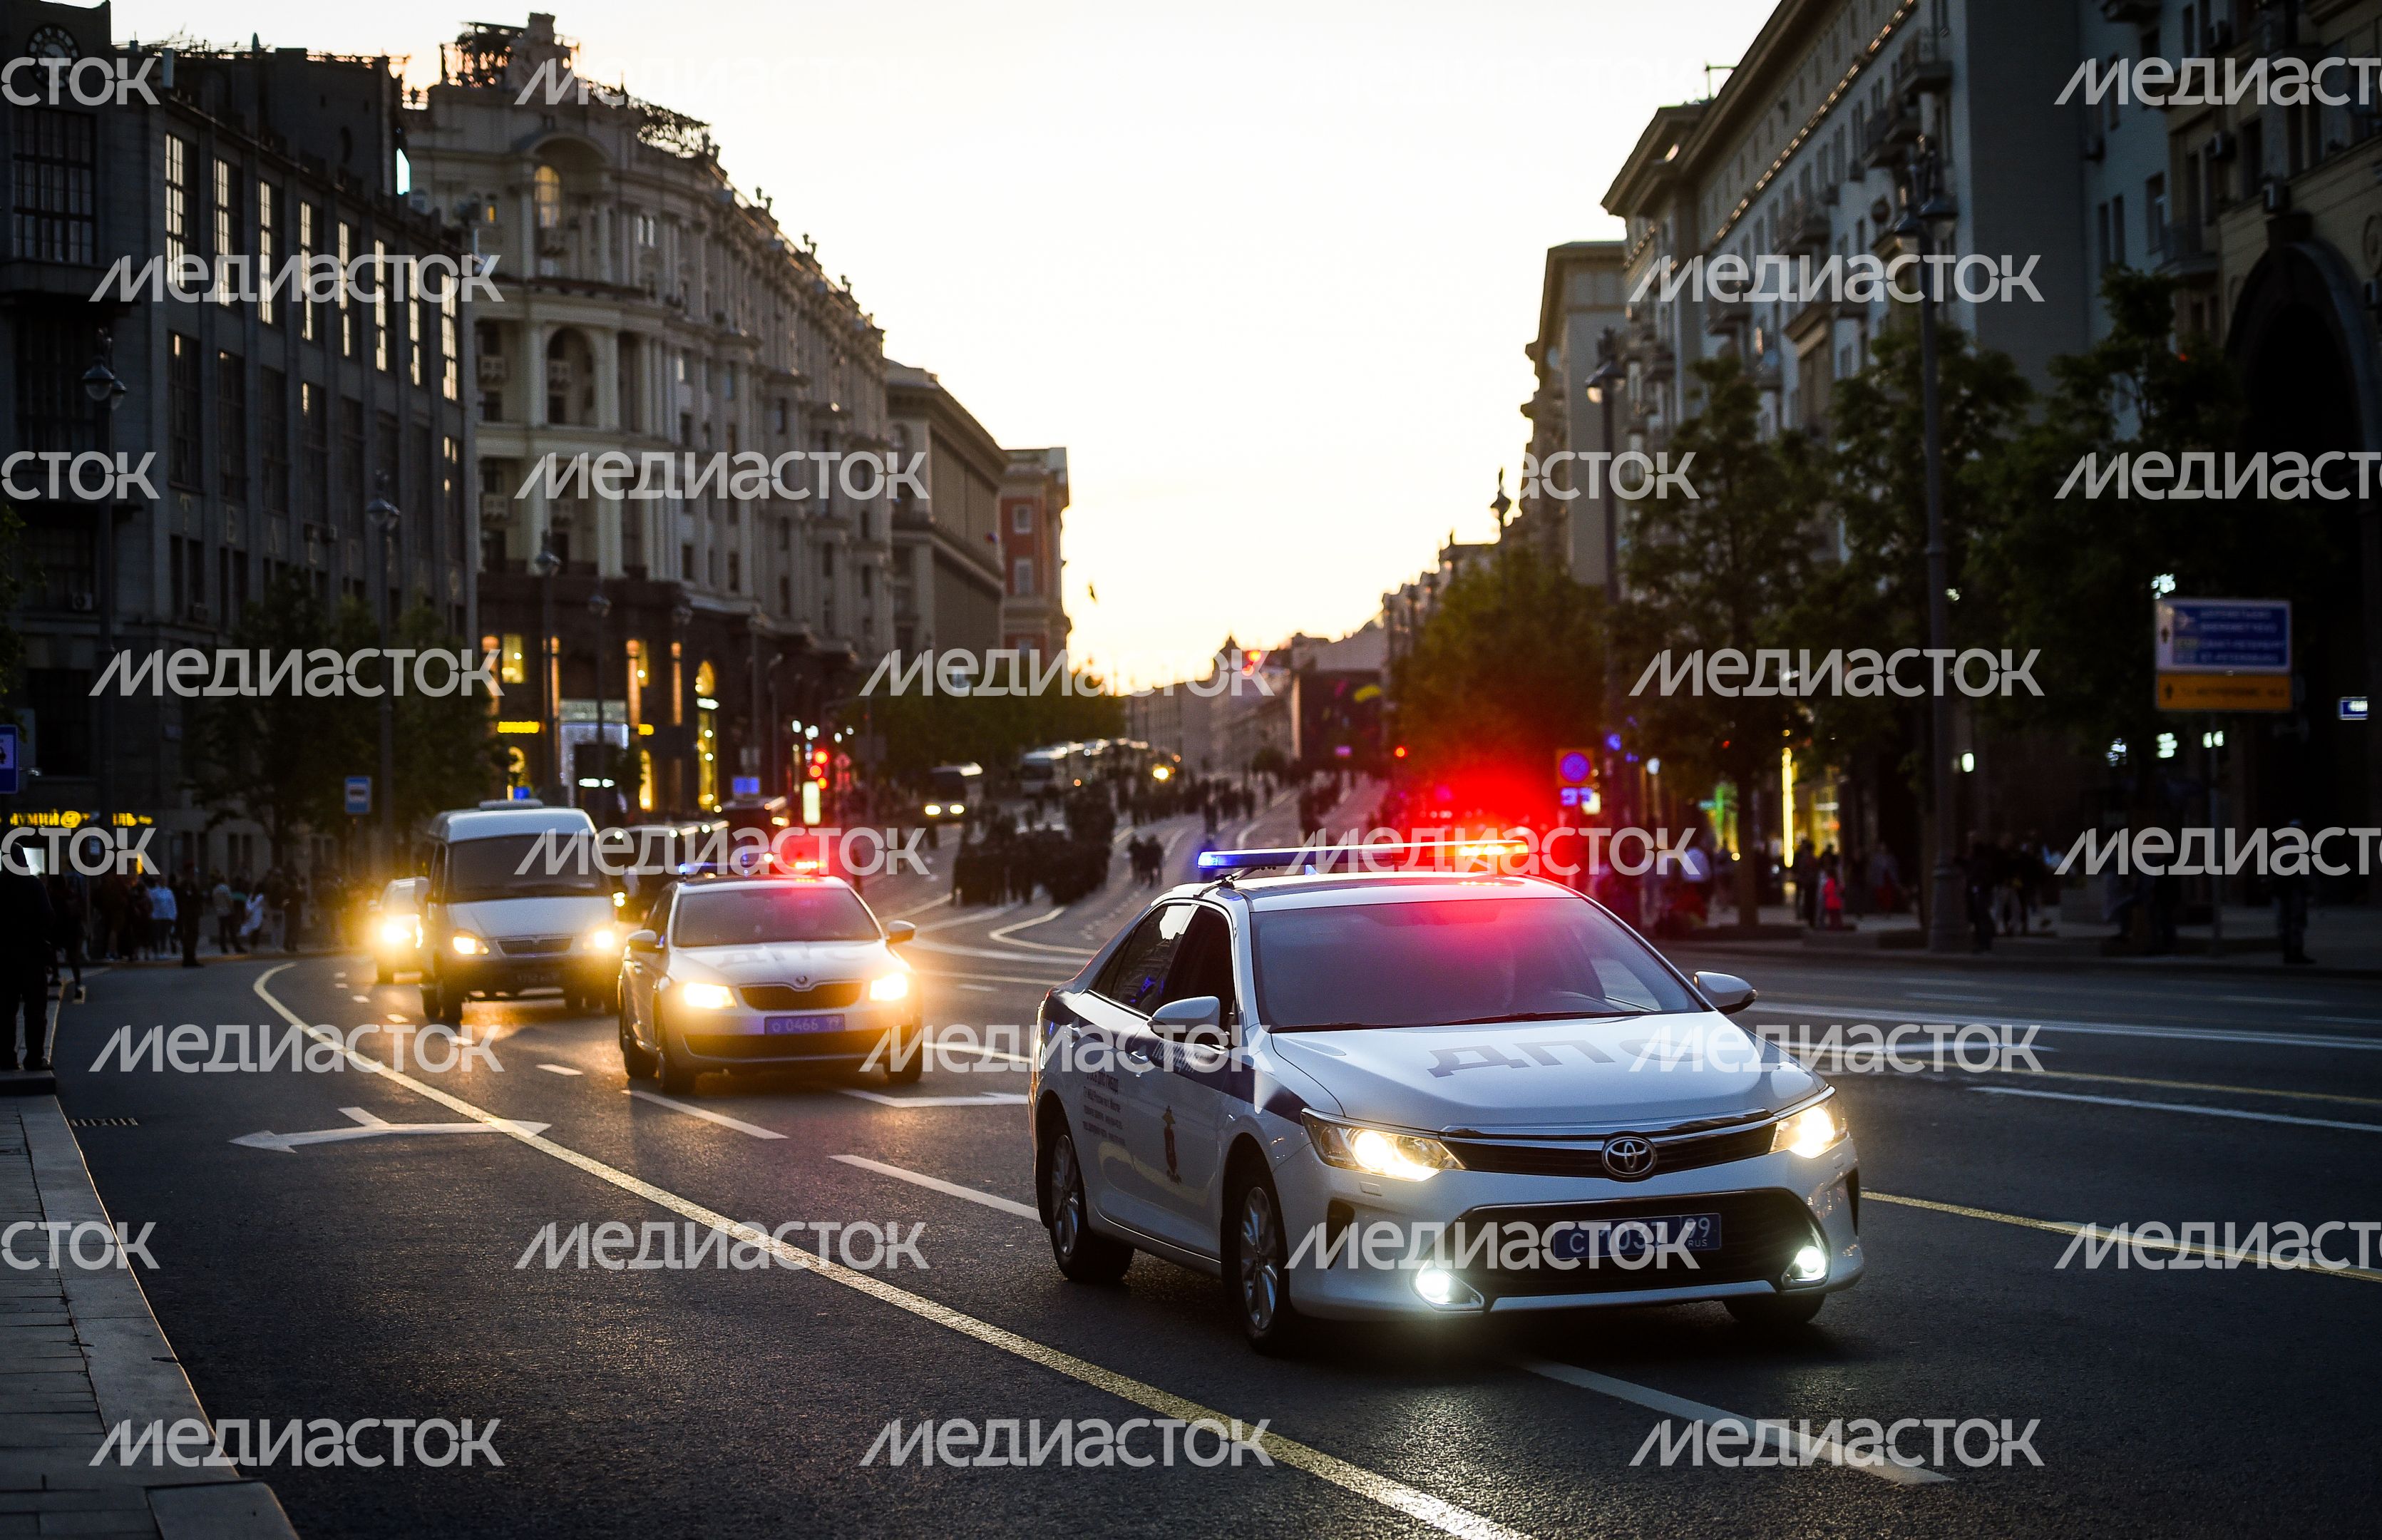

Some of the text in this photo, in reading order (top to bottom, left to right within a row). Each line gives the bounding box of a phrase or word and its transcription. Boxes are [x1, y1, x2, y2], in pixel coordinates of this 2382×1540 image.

[1427, 1038, 1705, 1078] ДПС
[1569, 1232, 1585, 1253] С
[1686, 1216, 1712, 1239] 99
[1688, 1238, 1708, 1248] RUS
